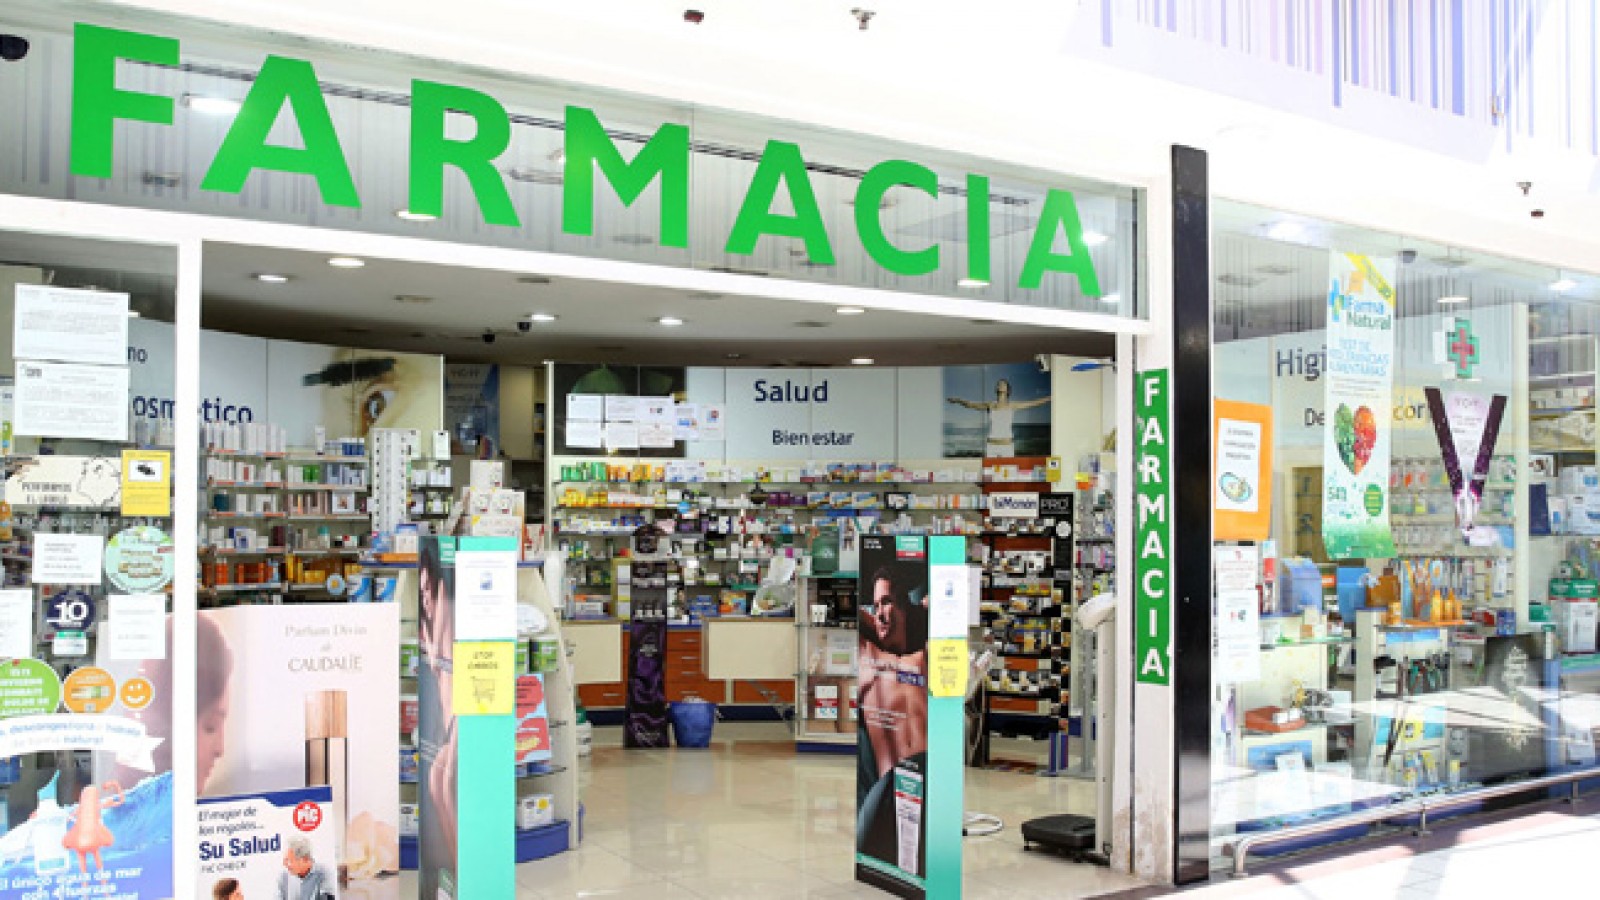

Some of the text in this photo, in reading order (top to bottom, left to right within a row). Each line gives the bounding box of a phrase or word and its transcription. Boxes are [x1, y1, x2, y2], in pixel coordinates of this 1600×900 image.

[69, 22, 1100, 297] FARMACIA
[1346, 312, 1392, 330] Natural
[753, 378, 829, 403] Salud
[1138, 376, 1166, 678] FARMACIA
[54, 602, 89, 622] 10
[198, 833, 281, 861] Su Salud
